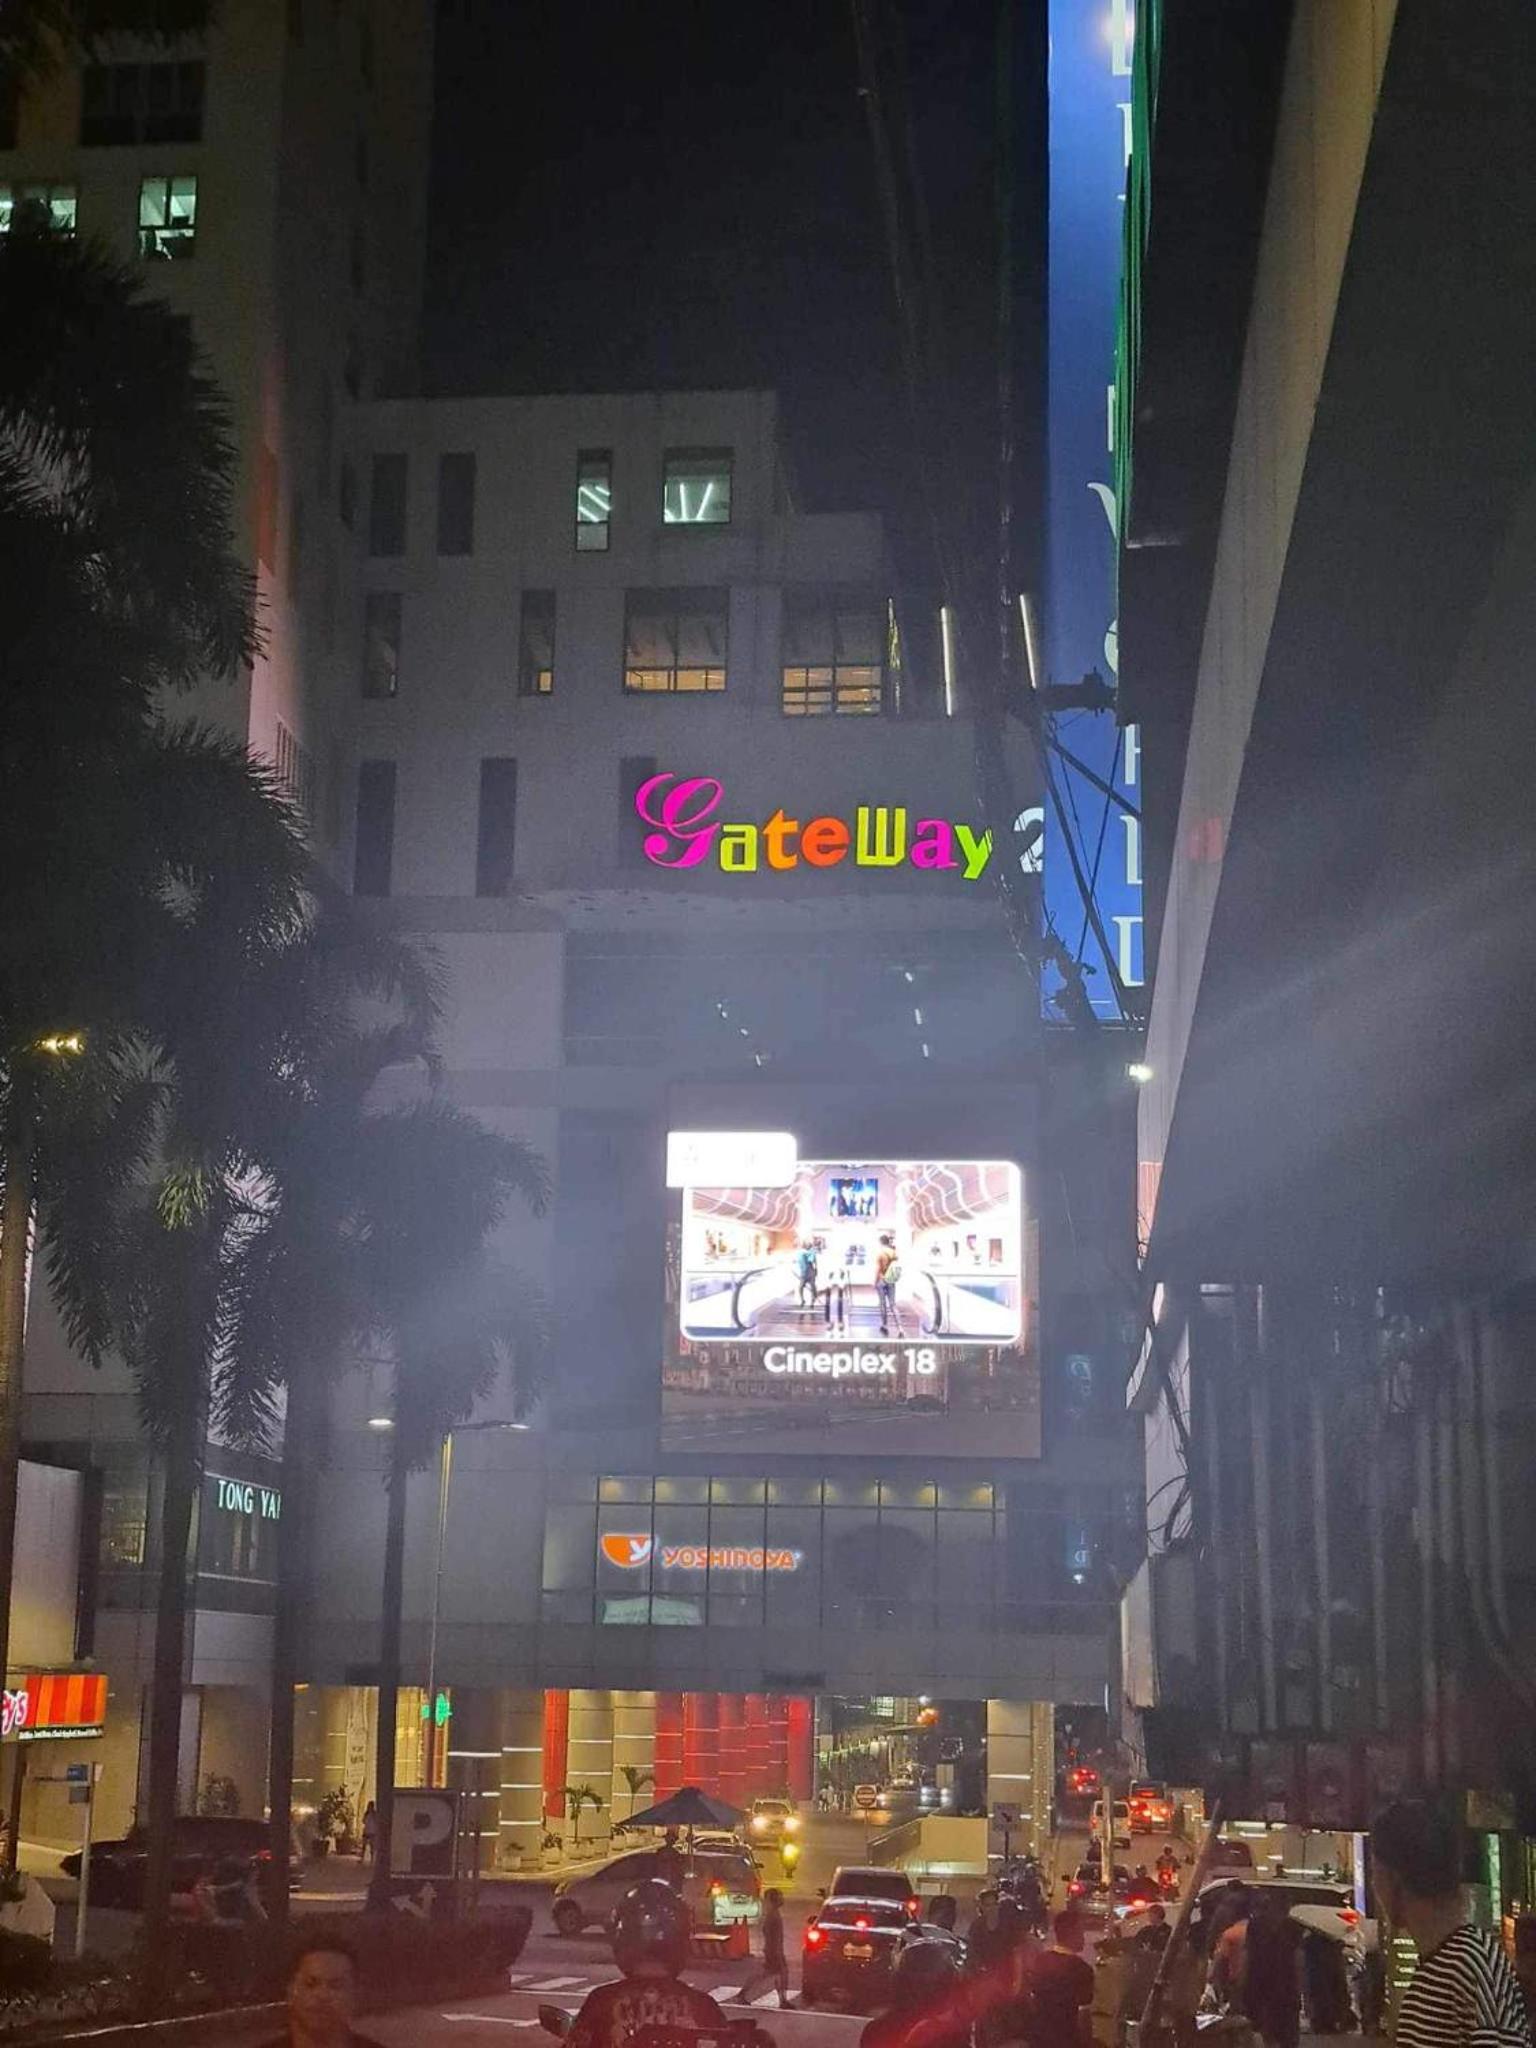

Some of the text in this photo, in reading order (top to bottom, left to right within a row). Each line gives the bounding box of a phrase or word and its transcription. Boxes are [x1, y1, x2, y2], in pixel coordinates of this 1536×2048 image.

[763, 1346, 936, 1379] Cineplex 18
[218, 1480, 255, 1514] TONG
[390, 1797, 454, 1873] P
